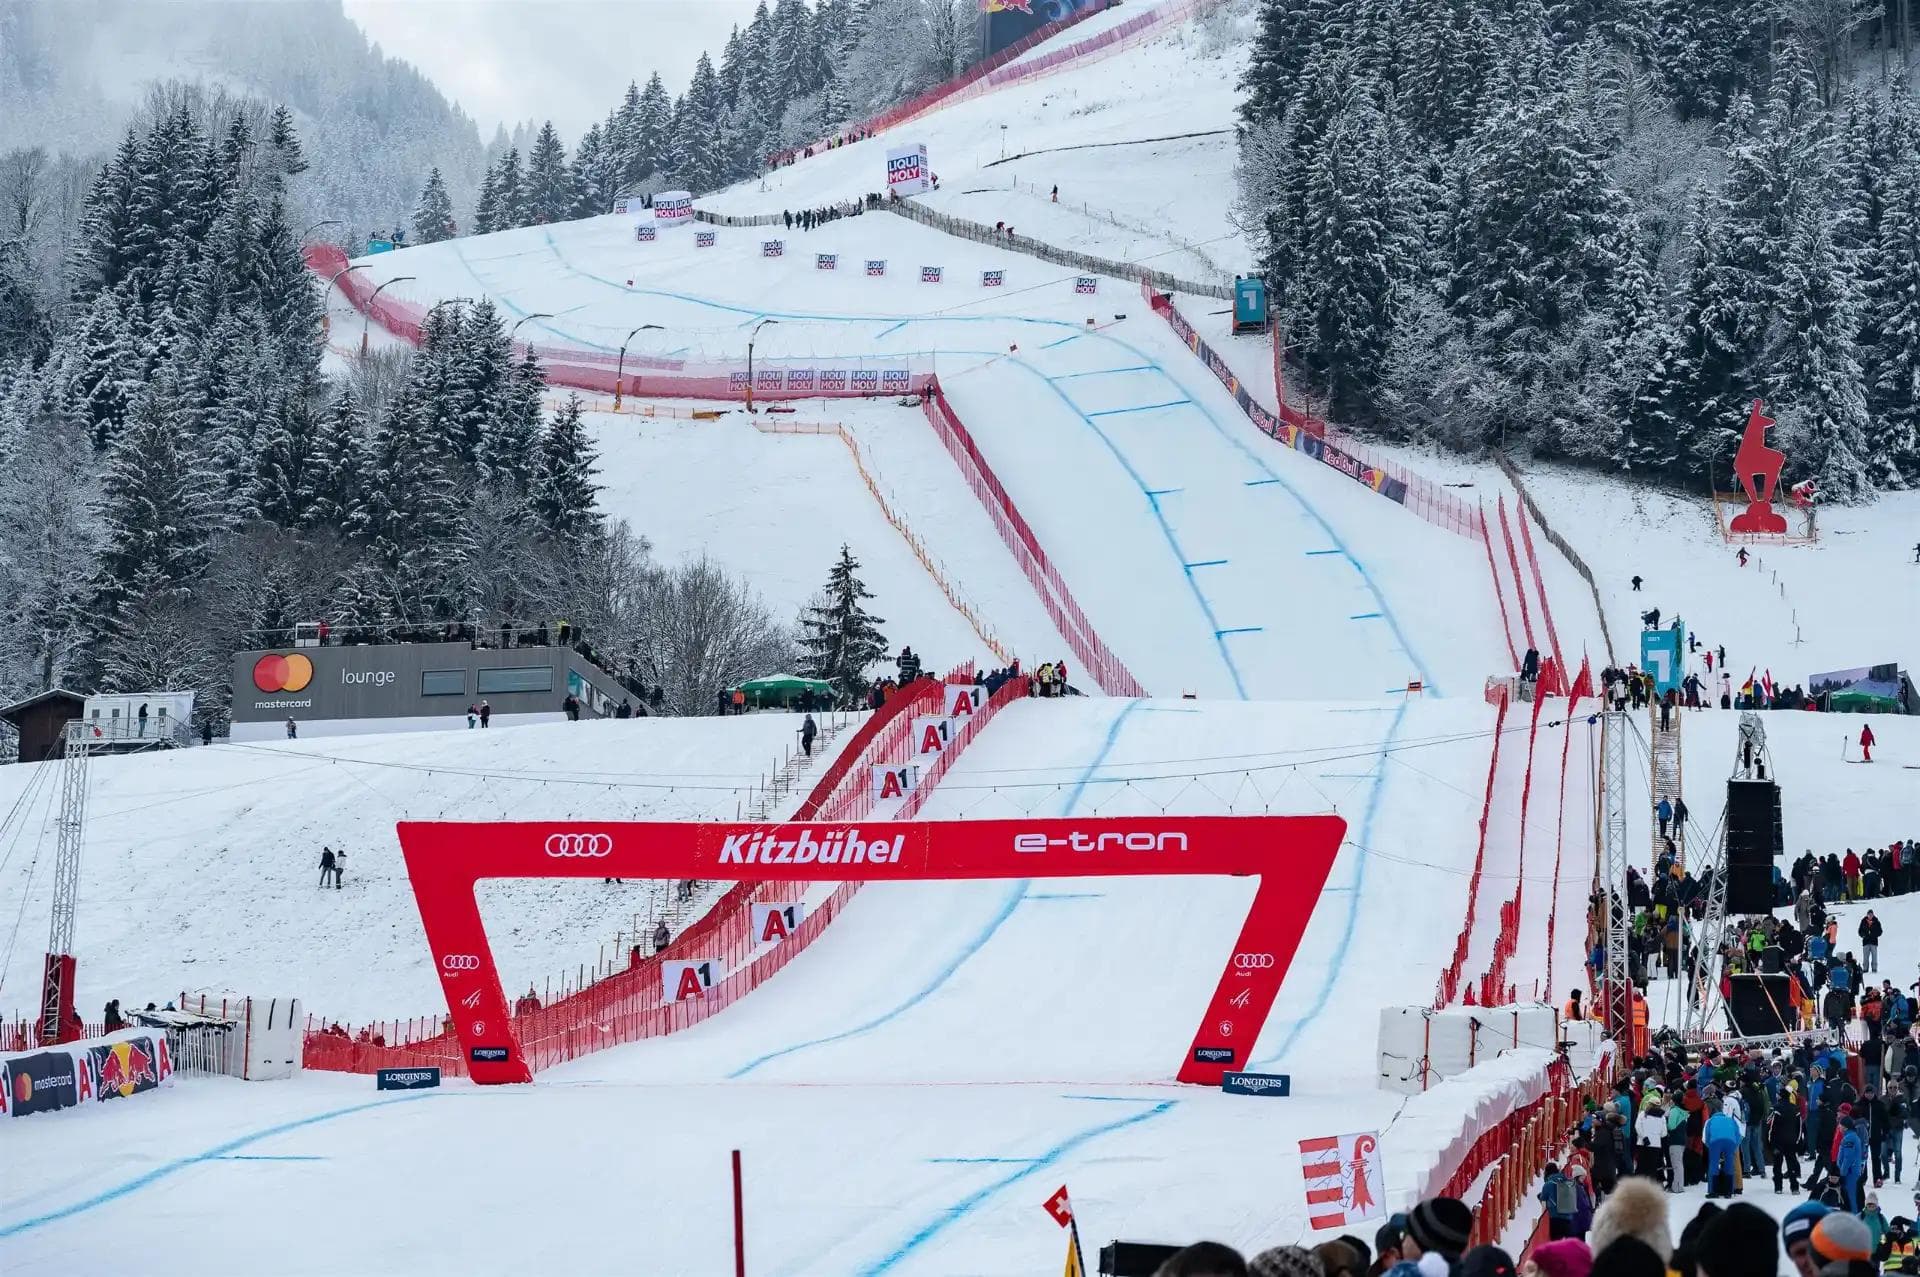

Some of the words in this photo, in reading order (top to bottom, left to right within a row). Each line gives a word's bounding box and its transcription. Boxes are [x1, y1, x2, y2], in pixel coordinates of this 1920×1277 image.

[888, 155, 919, 171] LIQUI
[890, 166, 920, 183] MOLY
[655, 209, 675, 218] MOLY
[757, 380, 781, 390] MOLY
[788, 380, 812, 390] MOLY
[820, 380, 844, 390] MOLY
[851, 380, 875, 390] MOLY
[883, 380, 908, 390] MOLY
[341, 668, 395, 686] lounge
[254, 699, 312, 709] mastercard
[952, 688, 979, 716] A1
[920, 720, 947, 754] A1
[880, 768, 908, 798] A1
[718, 829, 905, 865] Kitzbühel
[1014, 831, 1188, 852] e-tron
[762, 906, 795, 941] A1
[676, 962, 711, 1001] A1
[34, 1070, 73, 1091] mastercard
[385, 1072, 432, 1082] LONGINES
[1231, 1077, 1282, 1088] LONGINES
